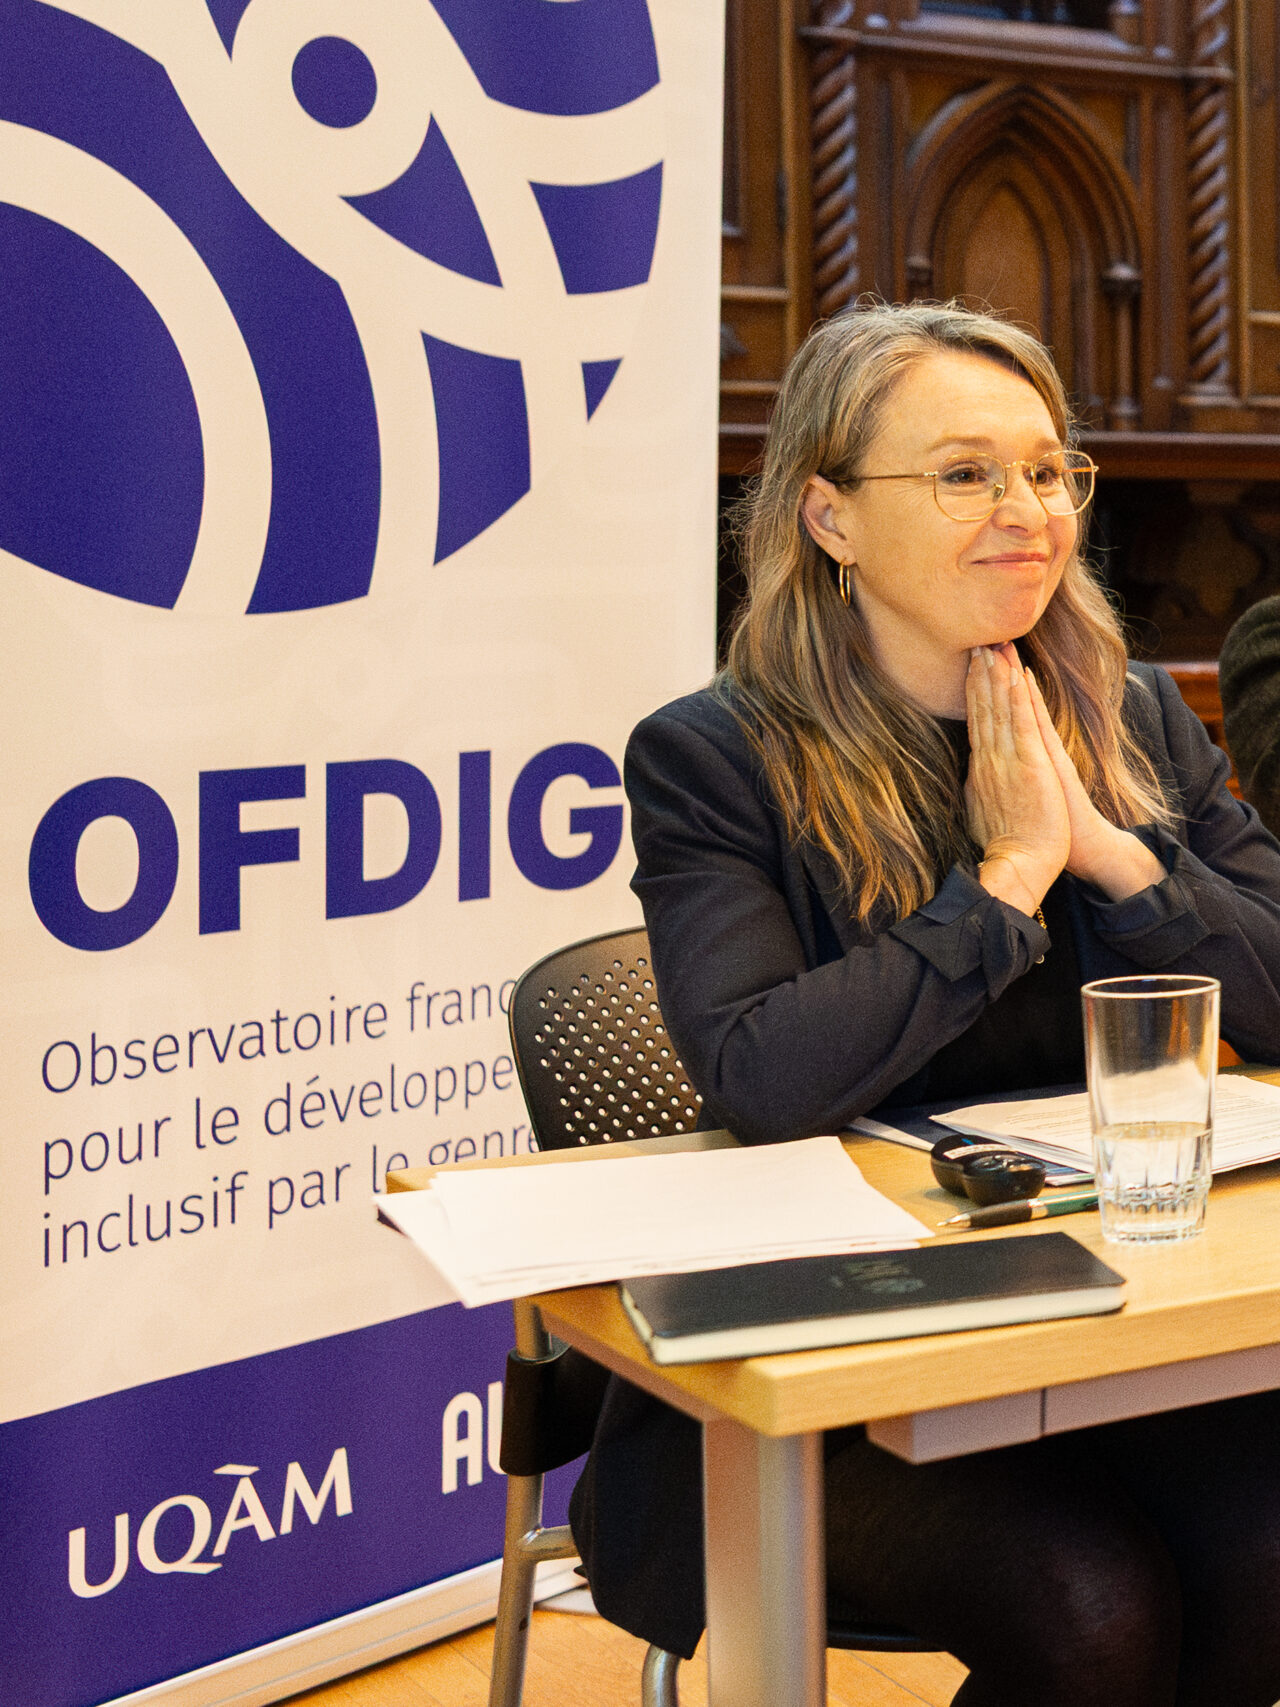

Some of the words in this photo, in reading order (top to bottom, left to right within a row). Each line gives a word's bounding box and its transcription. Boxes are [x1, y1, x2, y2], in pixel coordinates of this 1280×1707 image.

[28, 741, 624, 952] OFDIG
[42, 995, 388, 1093] Observatoire
[45, 1116, 172, 1195] pour
[193, 1097, 240, 1149] le
[264, 1056, 514, 1136] développe
[43, 1171, 249, 1268] inclusif
[268, 1163, 351, 1229] par
[372, 1145, 409, 1193] le
[68, 1446, 353, 1598] UQÀM
